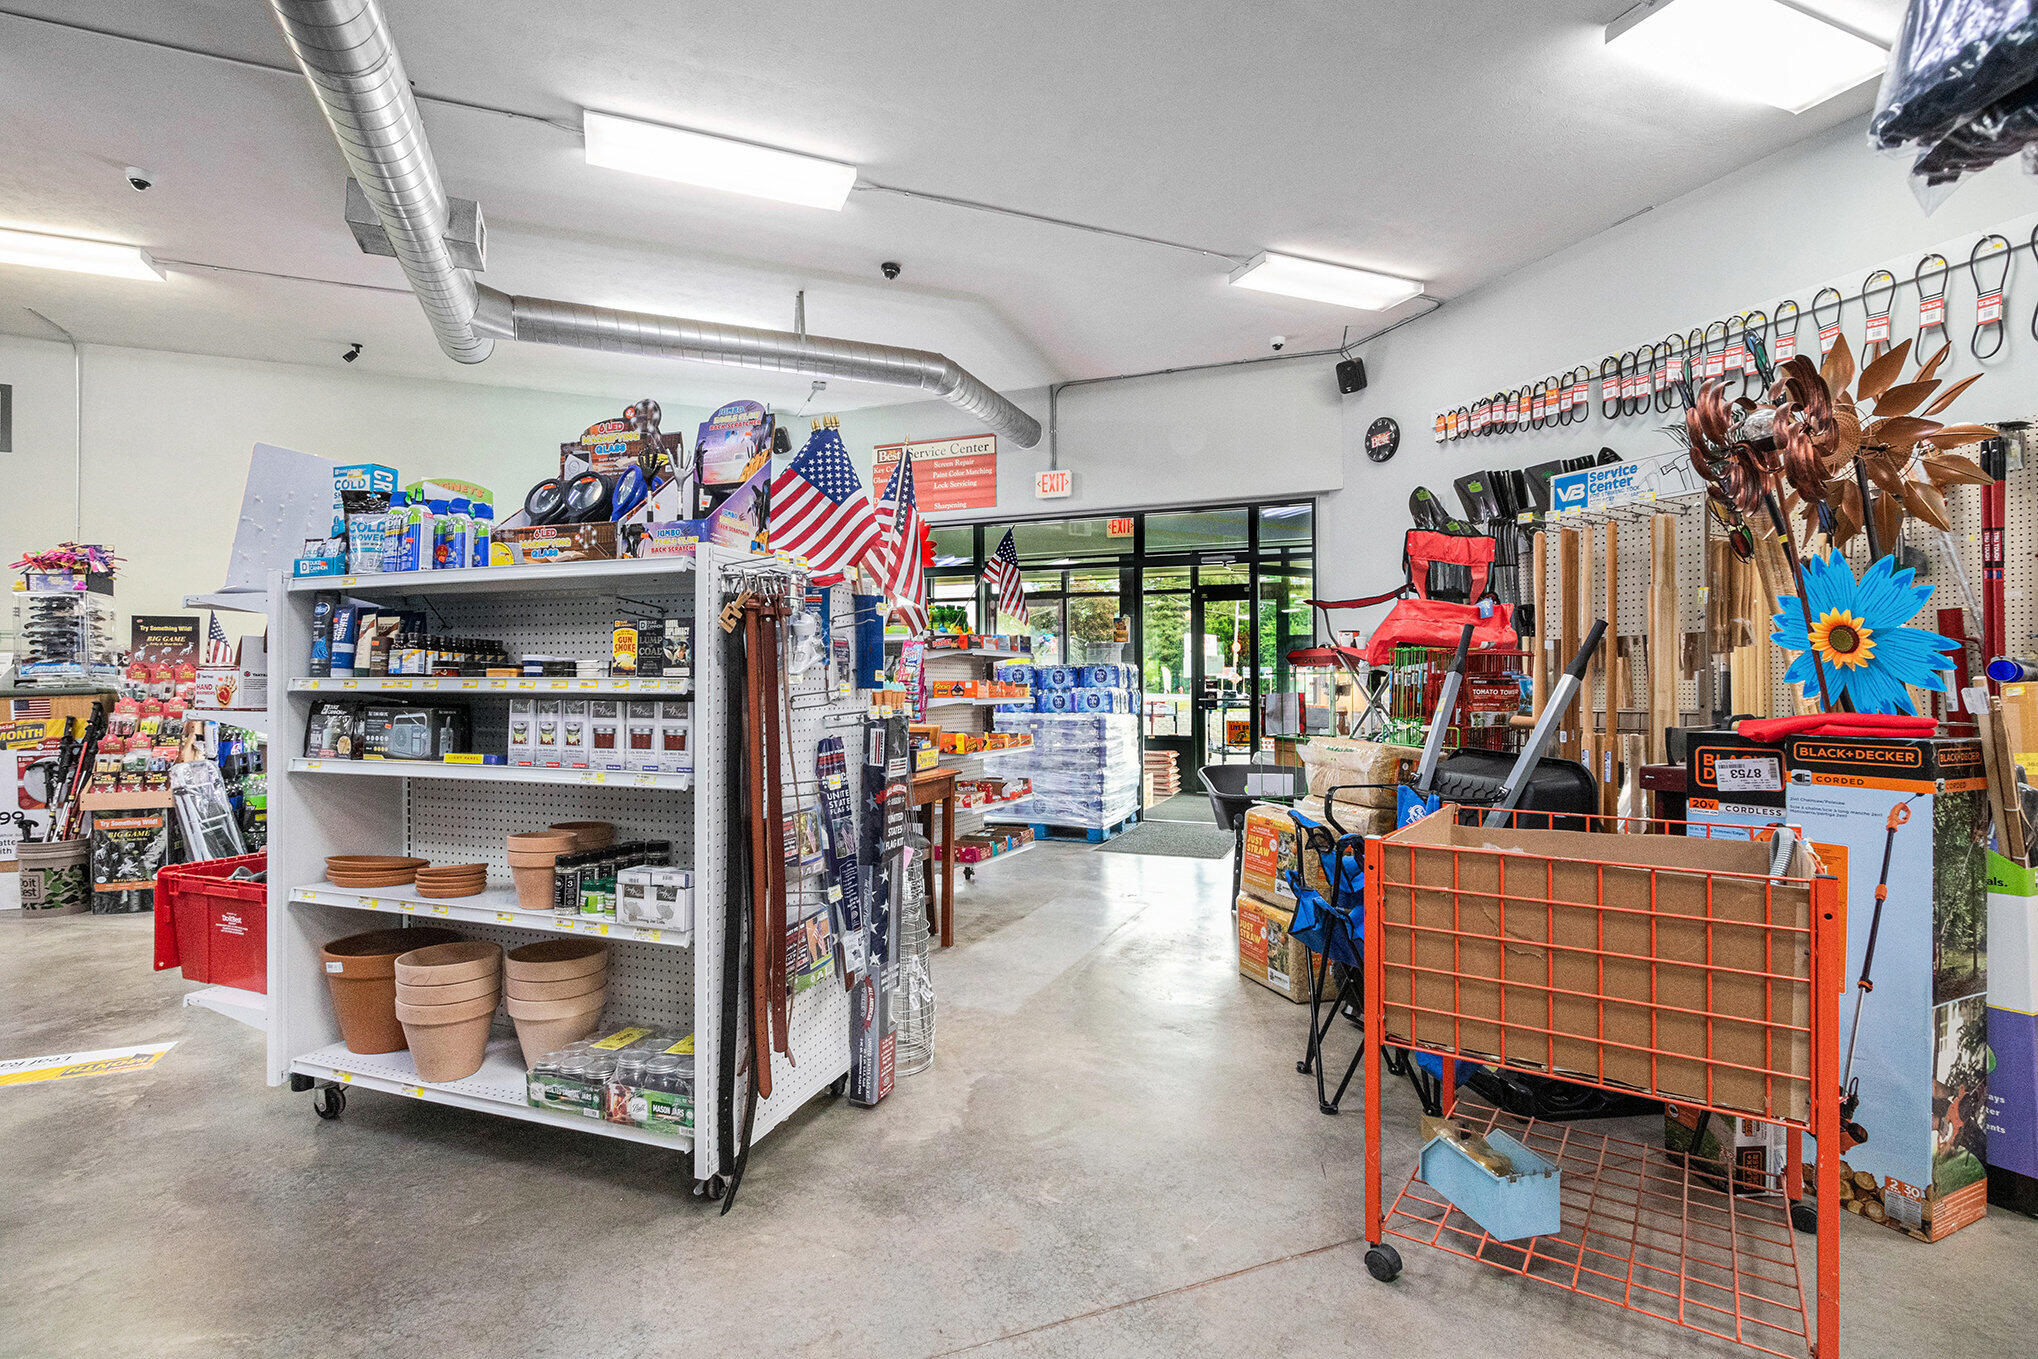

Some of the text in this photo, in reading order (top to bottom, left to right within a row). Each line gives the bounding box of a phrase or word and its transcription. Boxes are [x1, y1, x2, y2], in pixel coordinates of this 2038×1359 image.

[718, 406, 744, 416] JUMBO
[599, 421, 624, 432] 6 LED
[727, 420, 761, 429] SCRATCHER
[581, 431, 640, 445] MAGNIFYING
[595, 443, 627, 454] GLASS
[879, 442, 989, 462] Best Service Center
[934, 459, 975, 468] Screen Repair
[873, 466, 884, 474] Key
[933, 467, 993, 479] Paint Color Matching
[1589, 464, 1638, 482] Service
[334, 479, 366, 490] COLD
[949, 480, 977, 489] Servicing
[1041, 473, 1066, 493] EXIT
[1589, 476, 1633, 493] Center
[441, 482, 484, 498] GNETS
[1557, 484, 1585, 502] VB
[934, 502, 967, 510] Sharpening
[1111, 519, 1131, 534] EXIT
[534, 528, 557, 538] 6 LED
[657, 529, 681, 537] JUMBO
[519, 537, 571, 548] MAGNIFYING
[531, 549, 558, 558] GLASS
[618, 636, 633, 644] GUN
[639, 636, 663, 644] LUMP
[614, 643, 636, 653] SMOKE
[0, 728, 43, 741] MONTH
[1799, 747, 1915, 763] BLACK+DECKER
[1730, 769, 1762, 779] 8753
[1816, 775, 1865, 785] CORDED
[827, 789, 850, 800] UNITE
[829, 797, 851, 808] STATE
[1725, 805, 1782, 816] CORDLESS
[110, 819, 141, 827] Something
[1247, 834, 1263, 844] JUST
[1247, 843, 1270, 857] STRAW
[567, 880, 573, 888] 3
[1239, 919, 1253, 930] JUST
[1239, 928, 1261, 944] STRAW
[1988, 1094, 2005, 1103] ays
[652, 1103, 684, 1117] MASON JARS
[1986, 1123, 2006, 1133] ents
[1889, 1179, 1920, 1198] 2 30
